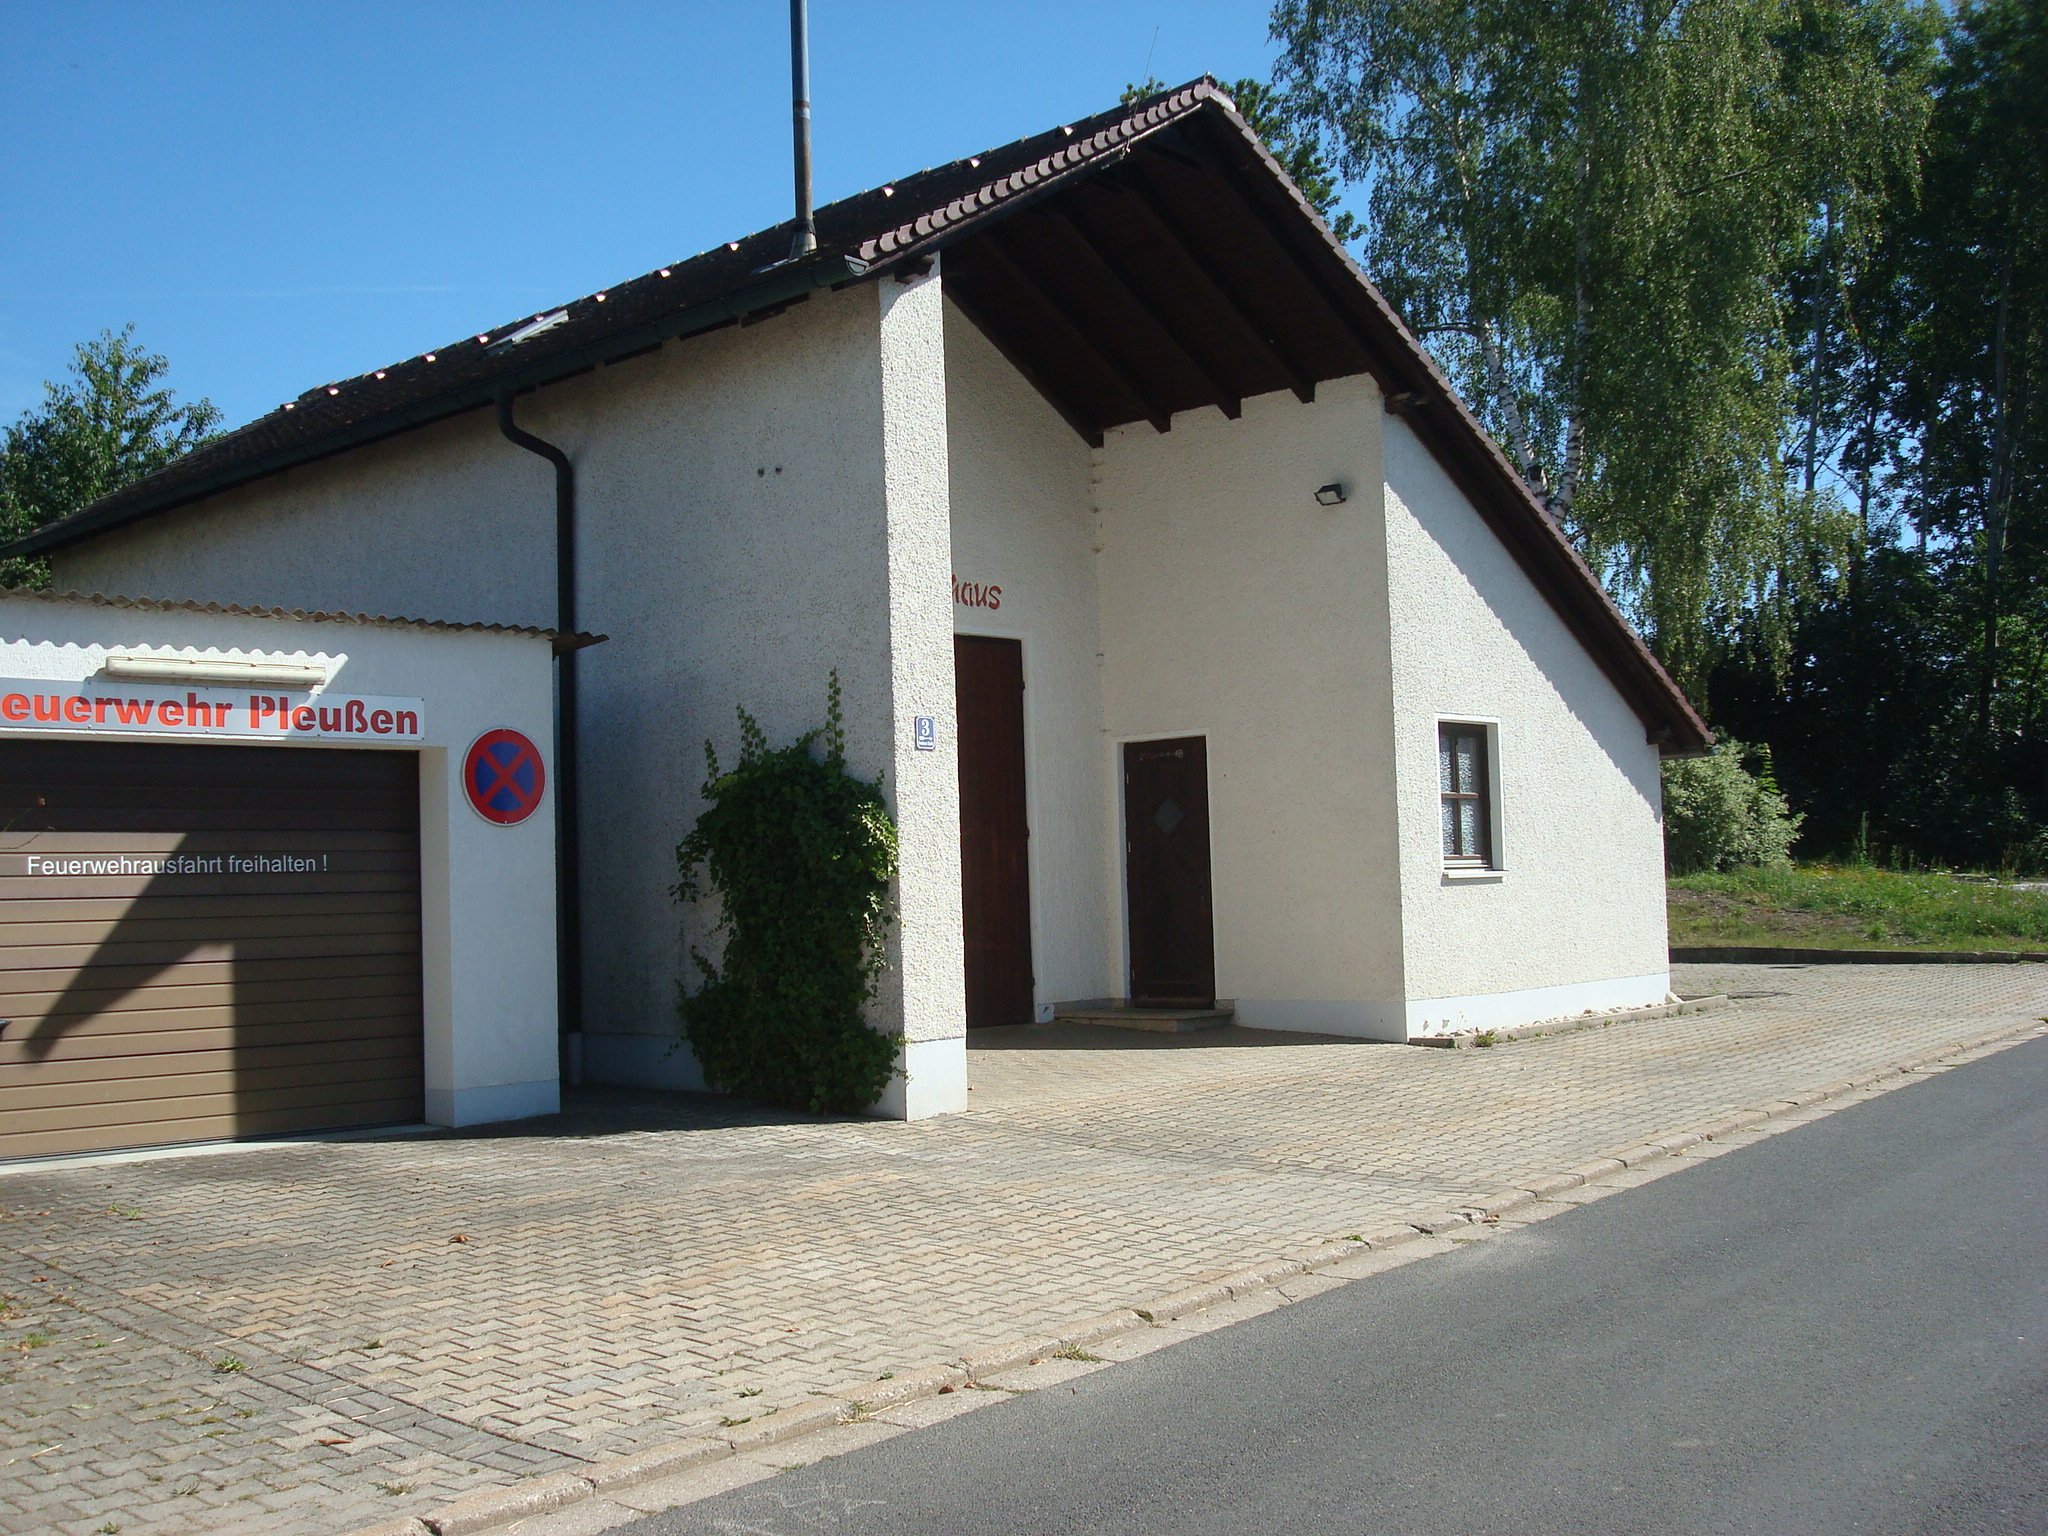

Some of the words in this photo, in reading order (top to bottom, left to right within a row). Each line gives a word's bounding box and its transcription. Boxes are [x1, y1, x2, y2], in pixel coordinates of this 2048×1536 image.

[250, 695, 418, 735] Pleußen
[921, 719, 930, 736] 3
[28, 855, 222, 875] Feuerwehrausfahrt
[228, 855, 316, 873] freihalten
